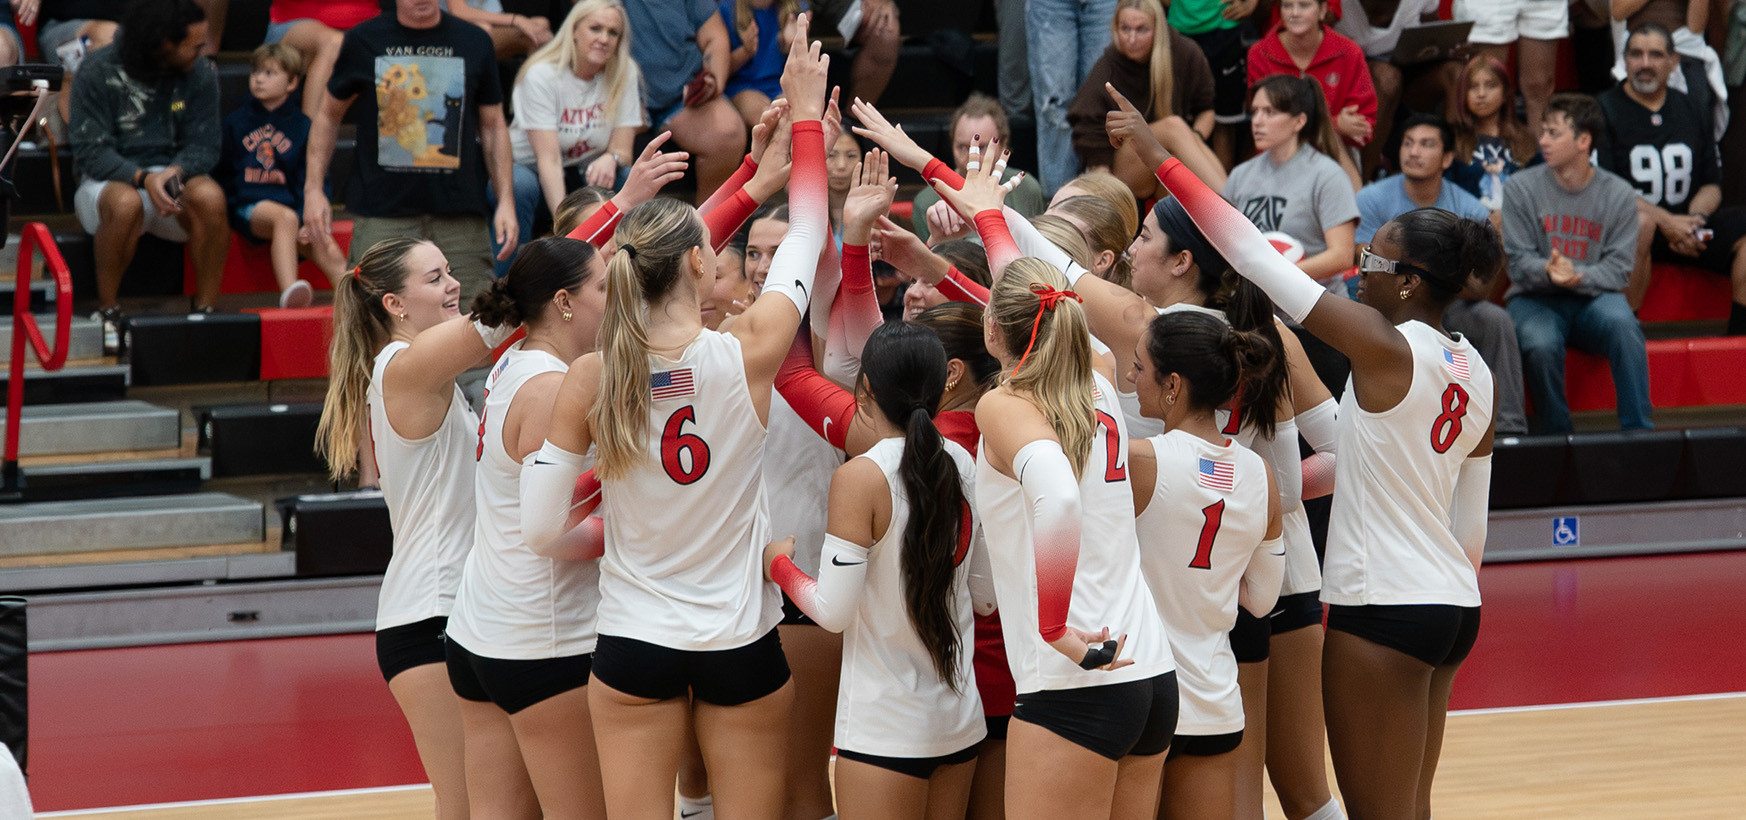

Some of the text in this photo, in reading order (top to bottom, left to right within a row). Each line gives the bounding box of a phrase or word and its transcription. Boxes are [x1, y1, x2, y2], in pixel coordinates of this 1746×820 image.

[386, 46, 454, 57] VAN GOGH
[1629, 142, 1694, 206] 98
[660, 404, 711, 486] 6
[1430, 383, 1470, 454] 8
[1188, 498, 1226, 570] 1
